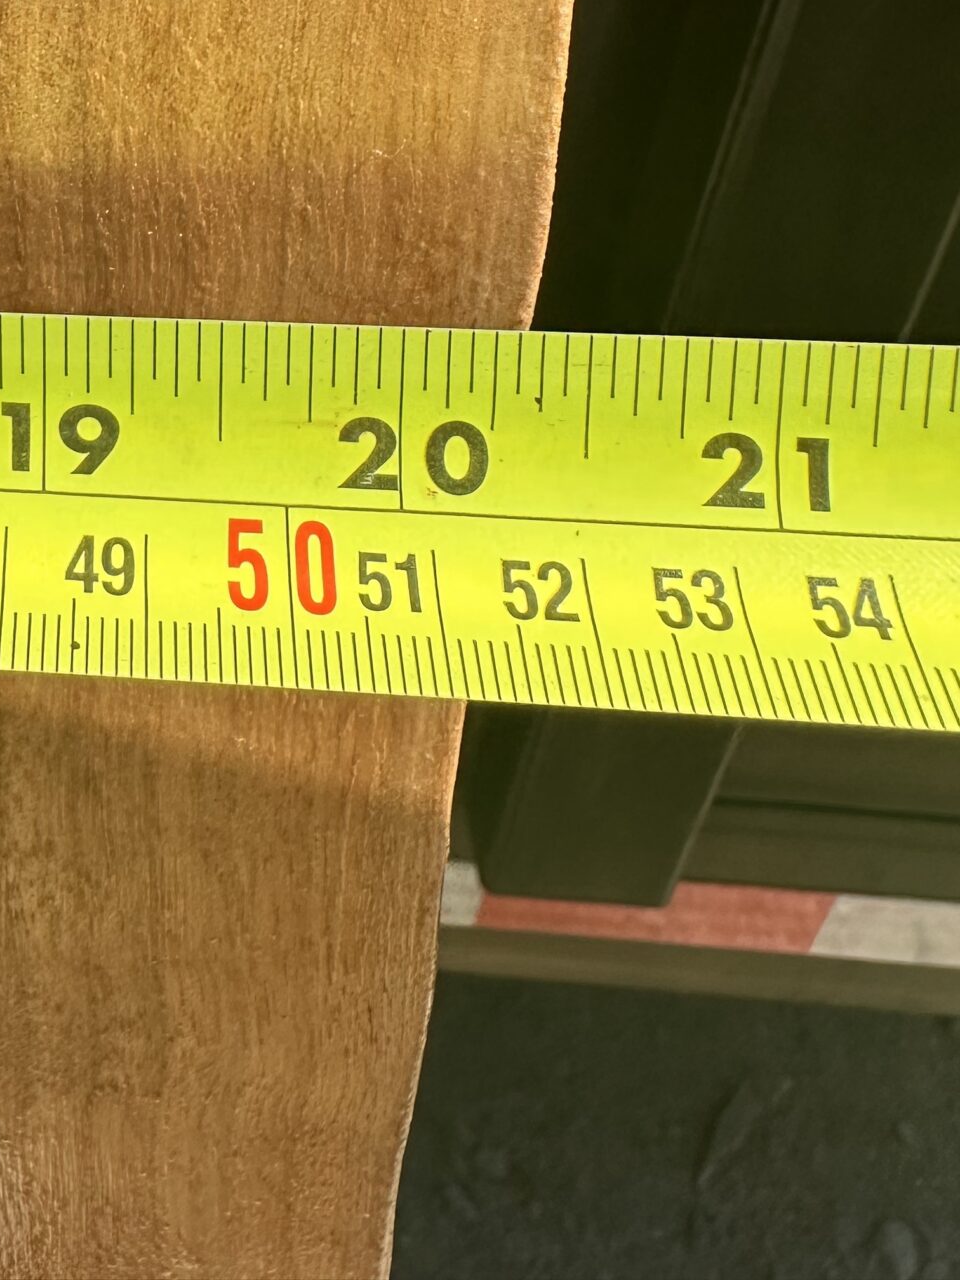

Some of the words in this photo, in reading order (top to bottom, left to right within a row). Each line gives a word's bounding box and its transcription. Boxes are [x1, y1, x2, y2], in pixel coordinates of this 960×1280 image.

[1, 401, 121, 475] 19
[337, 415, 489, 496] 20
[701, 431, 832, 513] 21
[65, 533, 136, 597] 49
[226, 517, 338, 616] 50
[357, 550, 423, 614] 51
[500, 557, 581, 622] 52
[652, 566, 734, 632] 53
[806, 575, 894, 641] 54
